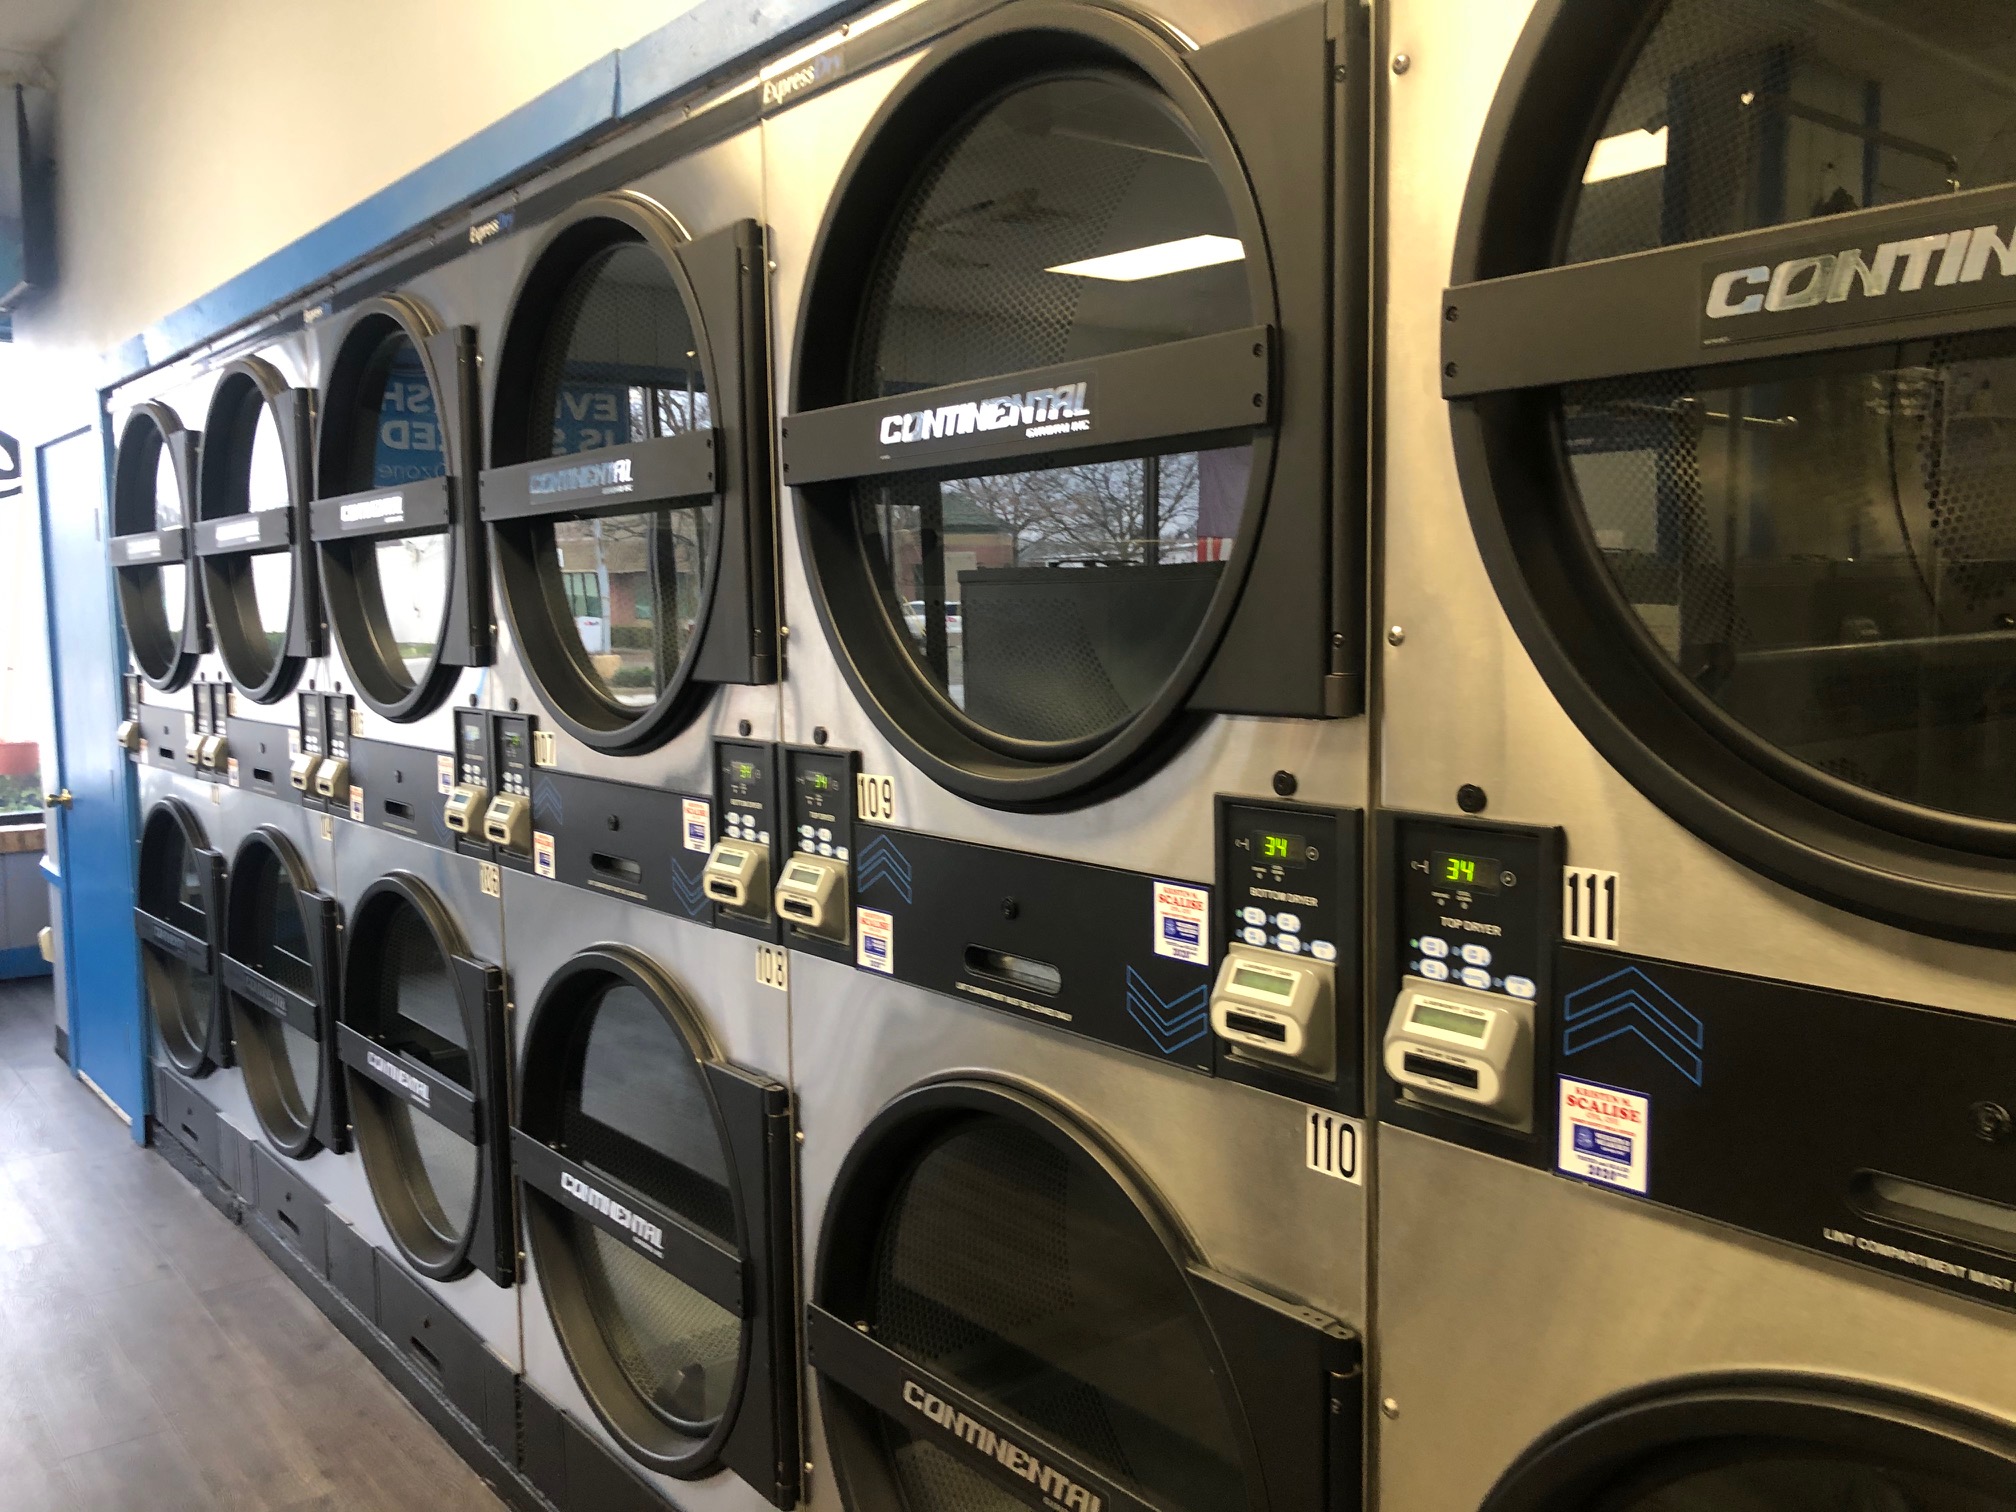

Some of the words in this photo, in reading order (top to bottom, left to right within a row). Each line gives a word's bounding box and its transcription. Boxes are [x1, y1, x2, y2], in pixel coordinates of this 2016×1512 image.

[879, 382, 1091, 444] CONTINENTAL
[858, 777, 895, 820] 109
[1264, 835, 1288, 858] 34
[1446, 858, 1475, 882] 34
[1440, 915, 1463, 929] TOP
[1463, 920, 1502, 936] DRYER
[1568, 872, 1617, 941] 111
[757, 944, 784, 987] 108
[1566, 1094, 1641, 1123] SCALISE
[1312, 1112, 1356, 1178] 110
[902, 1379, 1102, 1512] CONTINENTAL
